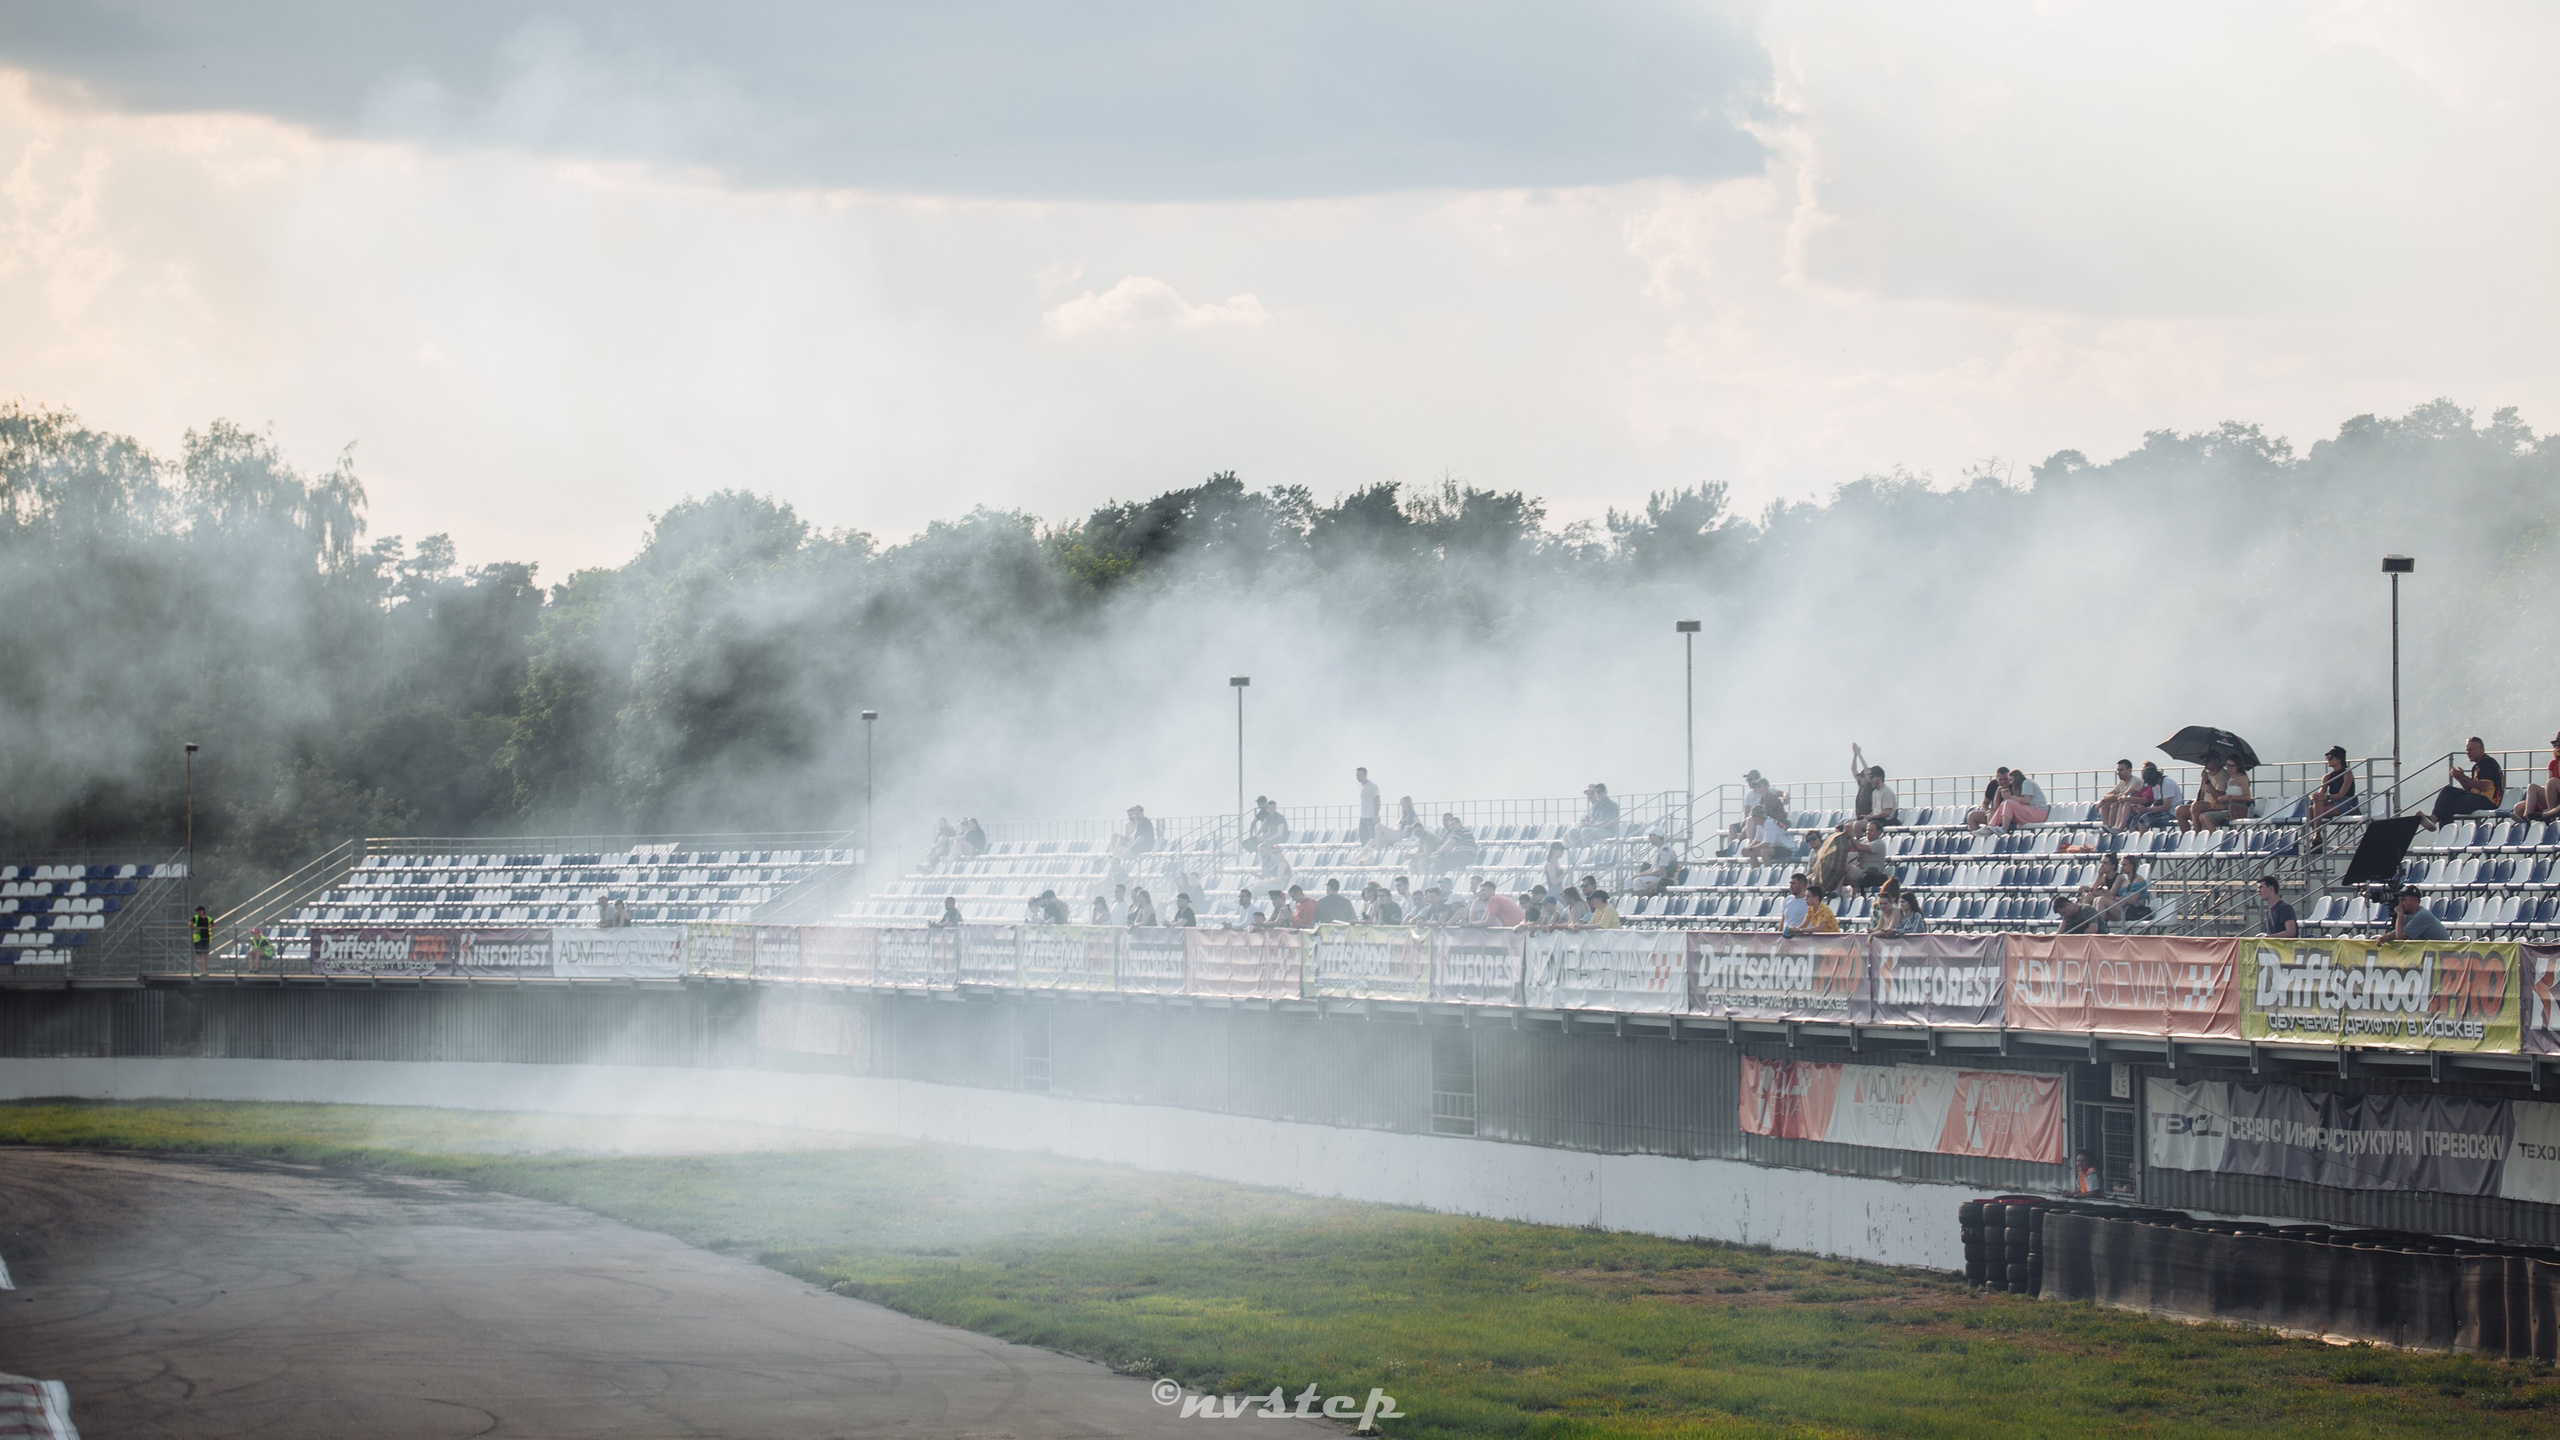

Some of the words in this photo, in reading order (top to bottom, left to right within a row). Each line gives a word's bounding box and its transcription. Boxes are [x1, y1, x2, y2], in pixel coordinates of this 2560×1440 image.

[1877, 946, 2001, 1007] KINFOREST
[1798, 997, 1805, 1008] В
[2268, 1012, 2340, 1031] ОБУЧЕНИЕ
[2345, 1016, 2401, 1035] ДРИФТУ
[2407, 1019, 2418, 1035] В
[2421, 1018, 2485, 1039] МОСКВЕ
[1869, 1073, 1899, 1104] ADM
[1981, 1080, 2015, 1112] ADM
